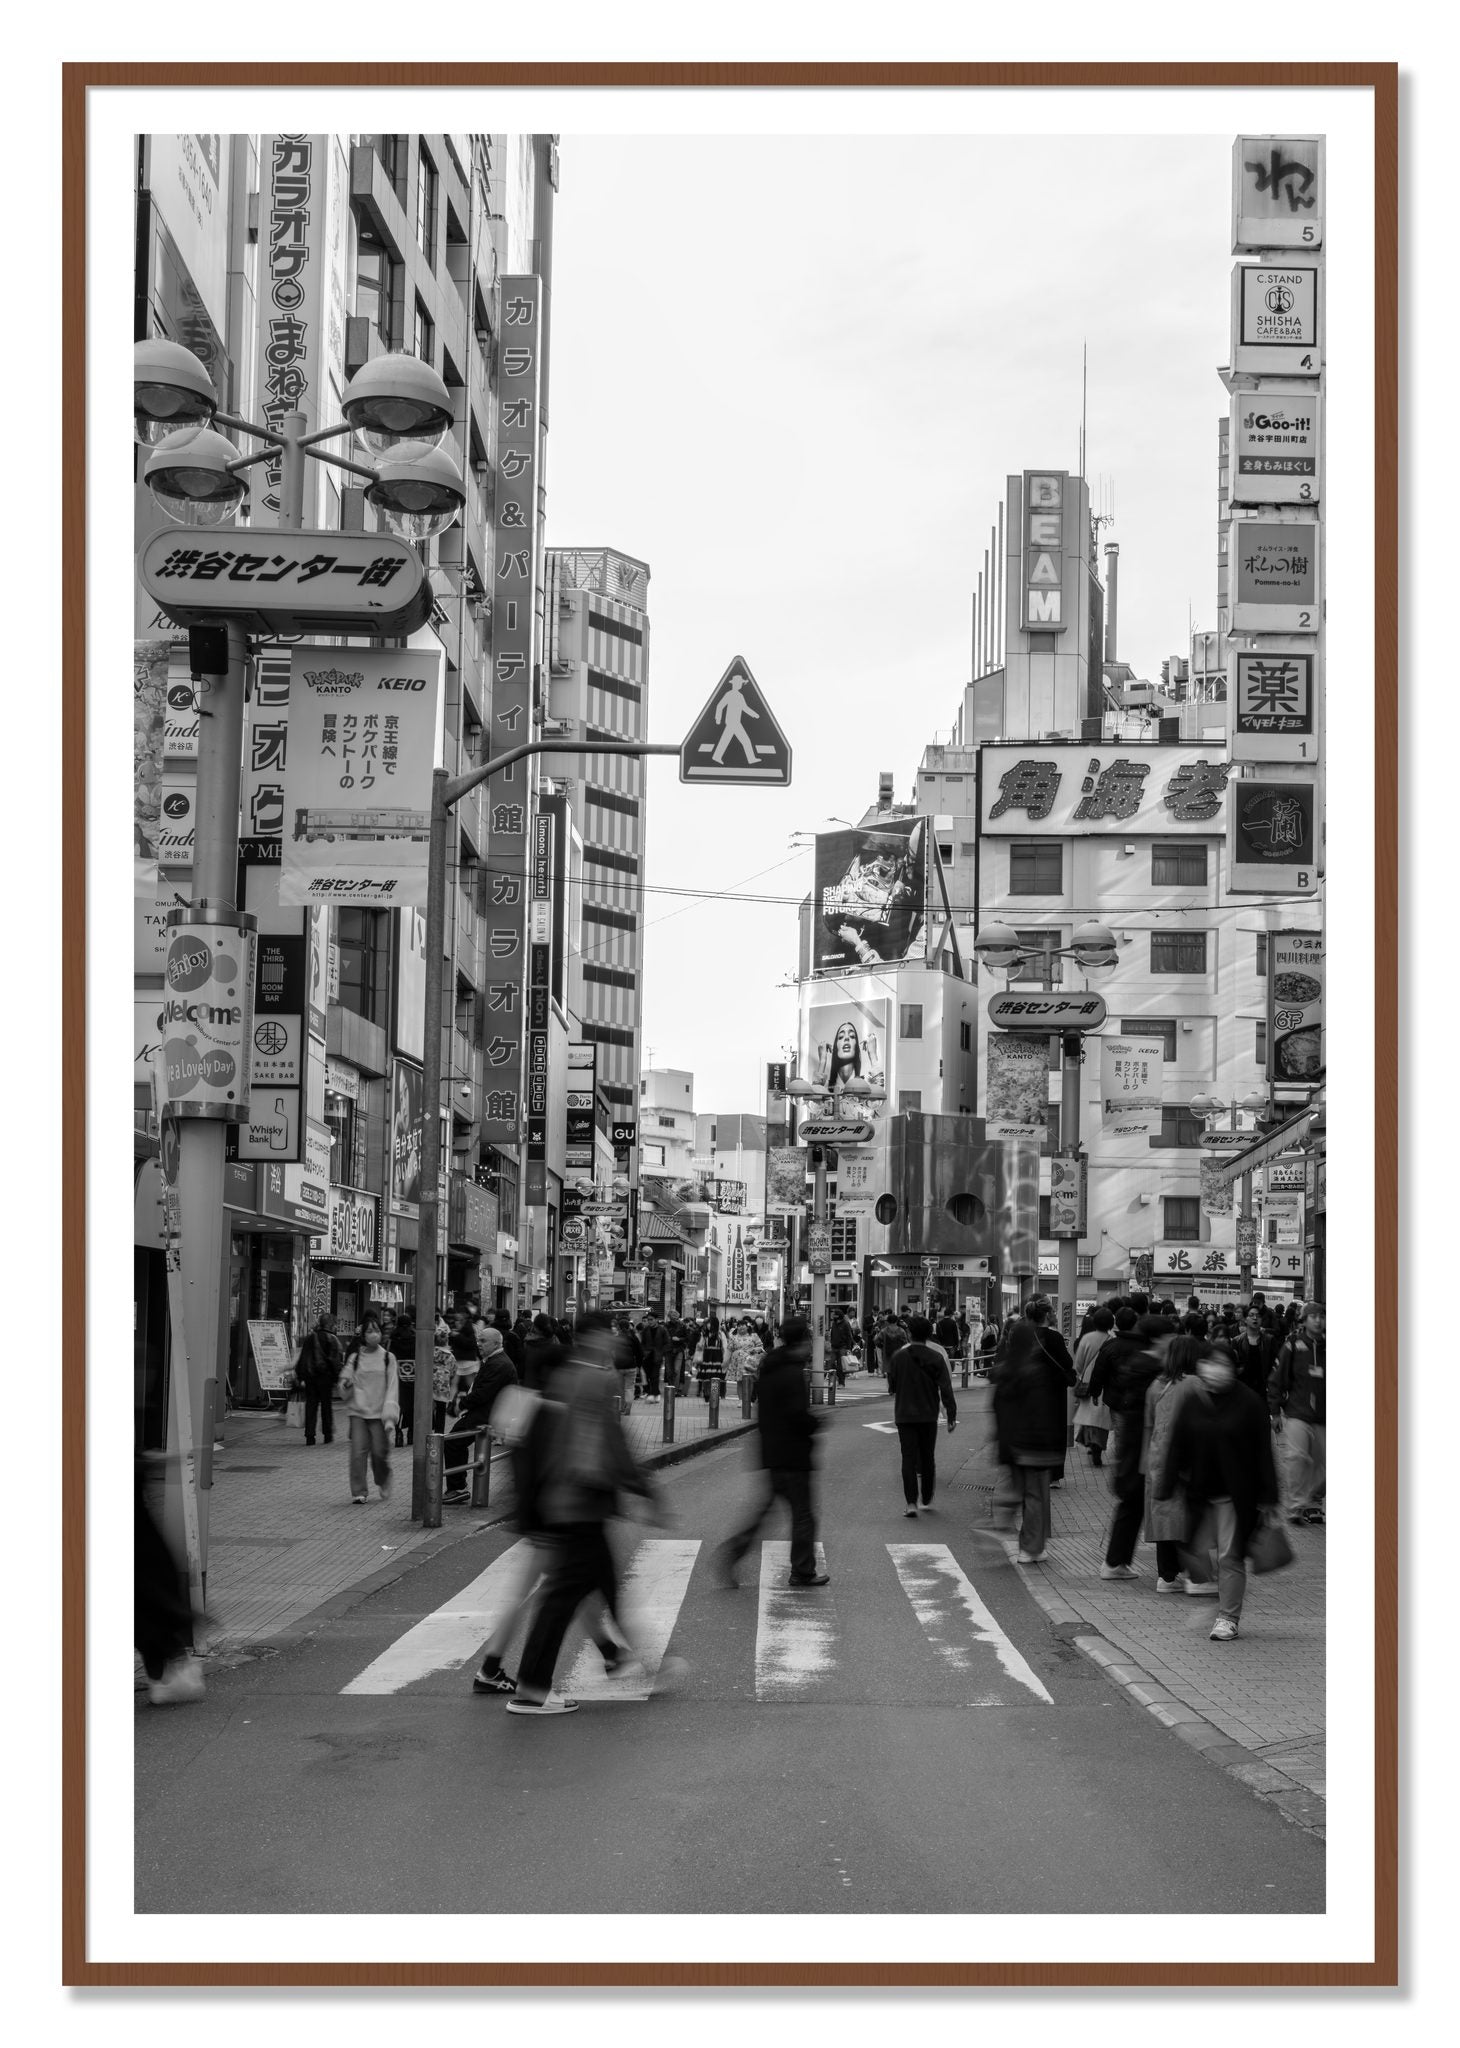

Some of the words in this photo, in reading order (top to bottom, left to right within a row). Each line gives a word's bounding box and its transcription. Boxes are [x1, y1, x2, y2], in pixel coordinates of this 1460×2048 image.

[270, 140, 313, 281] カラオケ
[1302, 226, 1314, 242] 5
[1257, 274, 1303, 284] C.STAND
[1257, 316, 1302, 326] SHISHA
[1256, 326, 1302, 335] CAFE&BAR
[1301, 354, 1313, 370] 4
[1255, 414, 1311, 431] Goo-it!
[1248, 434, 1307, 444] 渋谷宇田川町店
[1243, 460, 1312, 472] 全身もみほぐし
[1300, 483, 1312, 499] 3
[1030, 476, 1062, 622] BEAM
[155, 548, 409, 588] 渋谷センター街
[1299, 612, 1311, 628] 2
[316, 686, 352, 694] KANTO
[377, 677, 427, 692] KEIO
[1248, 661, 1299, 712] 薬
[1241, 715, 1304, 730] マツモトキヨシ
[320, 713, 337, 757] 冒険へ
[168, 742, 193, 751] 渋谷店
[340, 713, 358, 789] カントーの
[360, 713, 379, 789] ポケパーク
[382, 714, 400, 775] 京王線で
[1298, 742, 1307, 757] 1
[989, 758, 1235, 821] 角海老
[538, 819, 547, 855] kimono
[164, 850, 190, 859] 渋谷店
[308, 878, 398, 893] 渋谷センター街
[537, 860, 546, 895] hearts
[1298, 872, 1309, 887] B
[168, 949, 209, 984] Enjoy
[164, 999, 242, 1026] Welcome
[995, 1002, 1099, 1014] 渋谷センター街
[1274, 1010, 1304, 1031] 6F
[181, 1058, 212, 1078] Lovely
[213, 1060, 234, 1074] Day!
[249, 1125, 284, 1138] Whisky
[614, 1129, 634, 1139] GU
[249, 1136, 269, 1144] Bank
[735, 1247, 743, 1291] BEER
